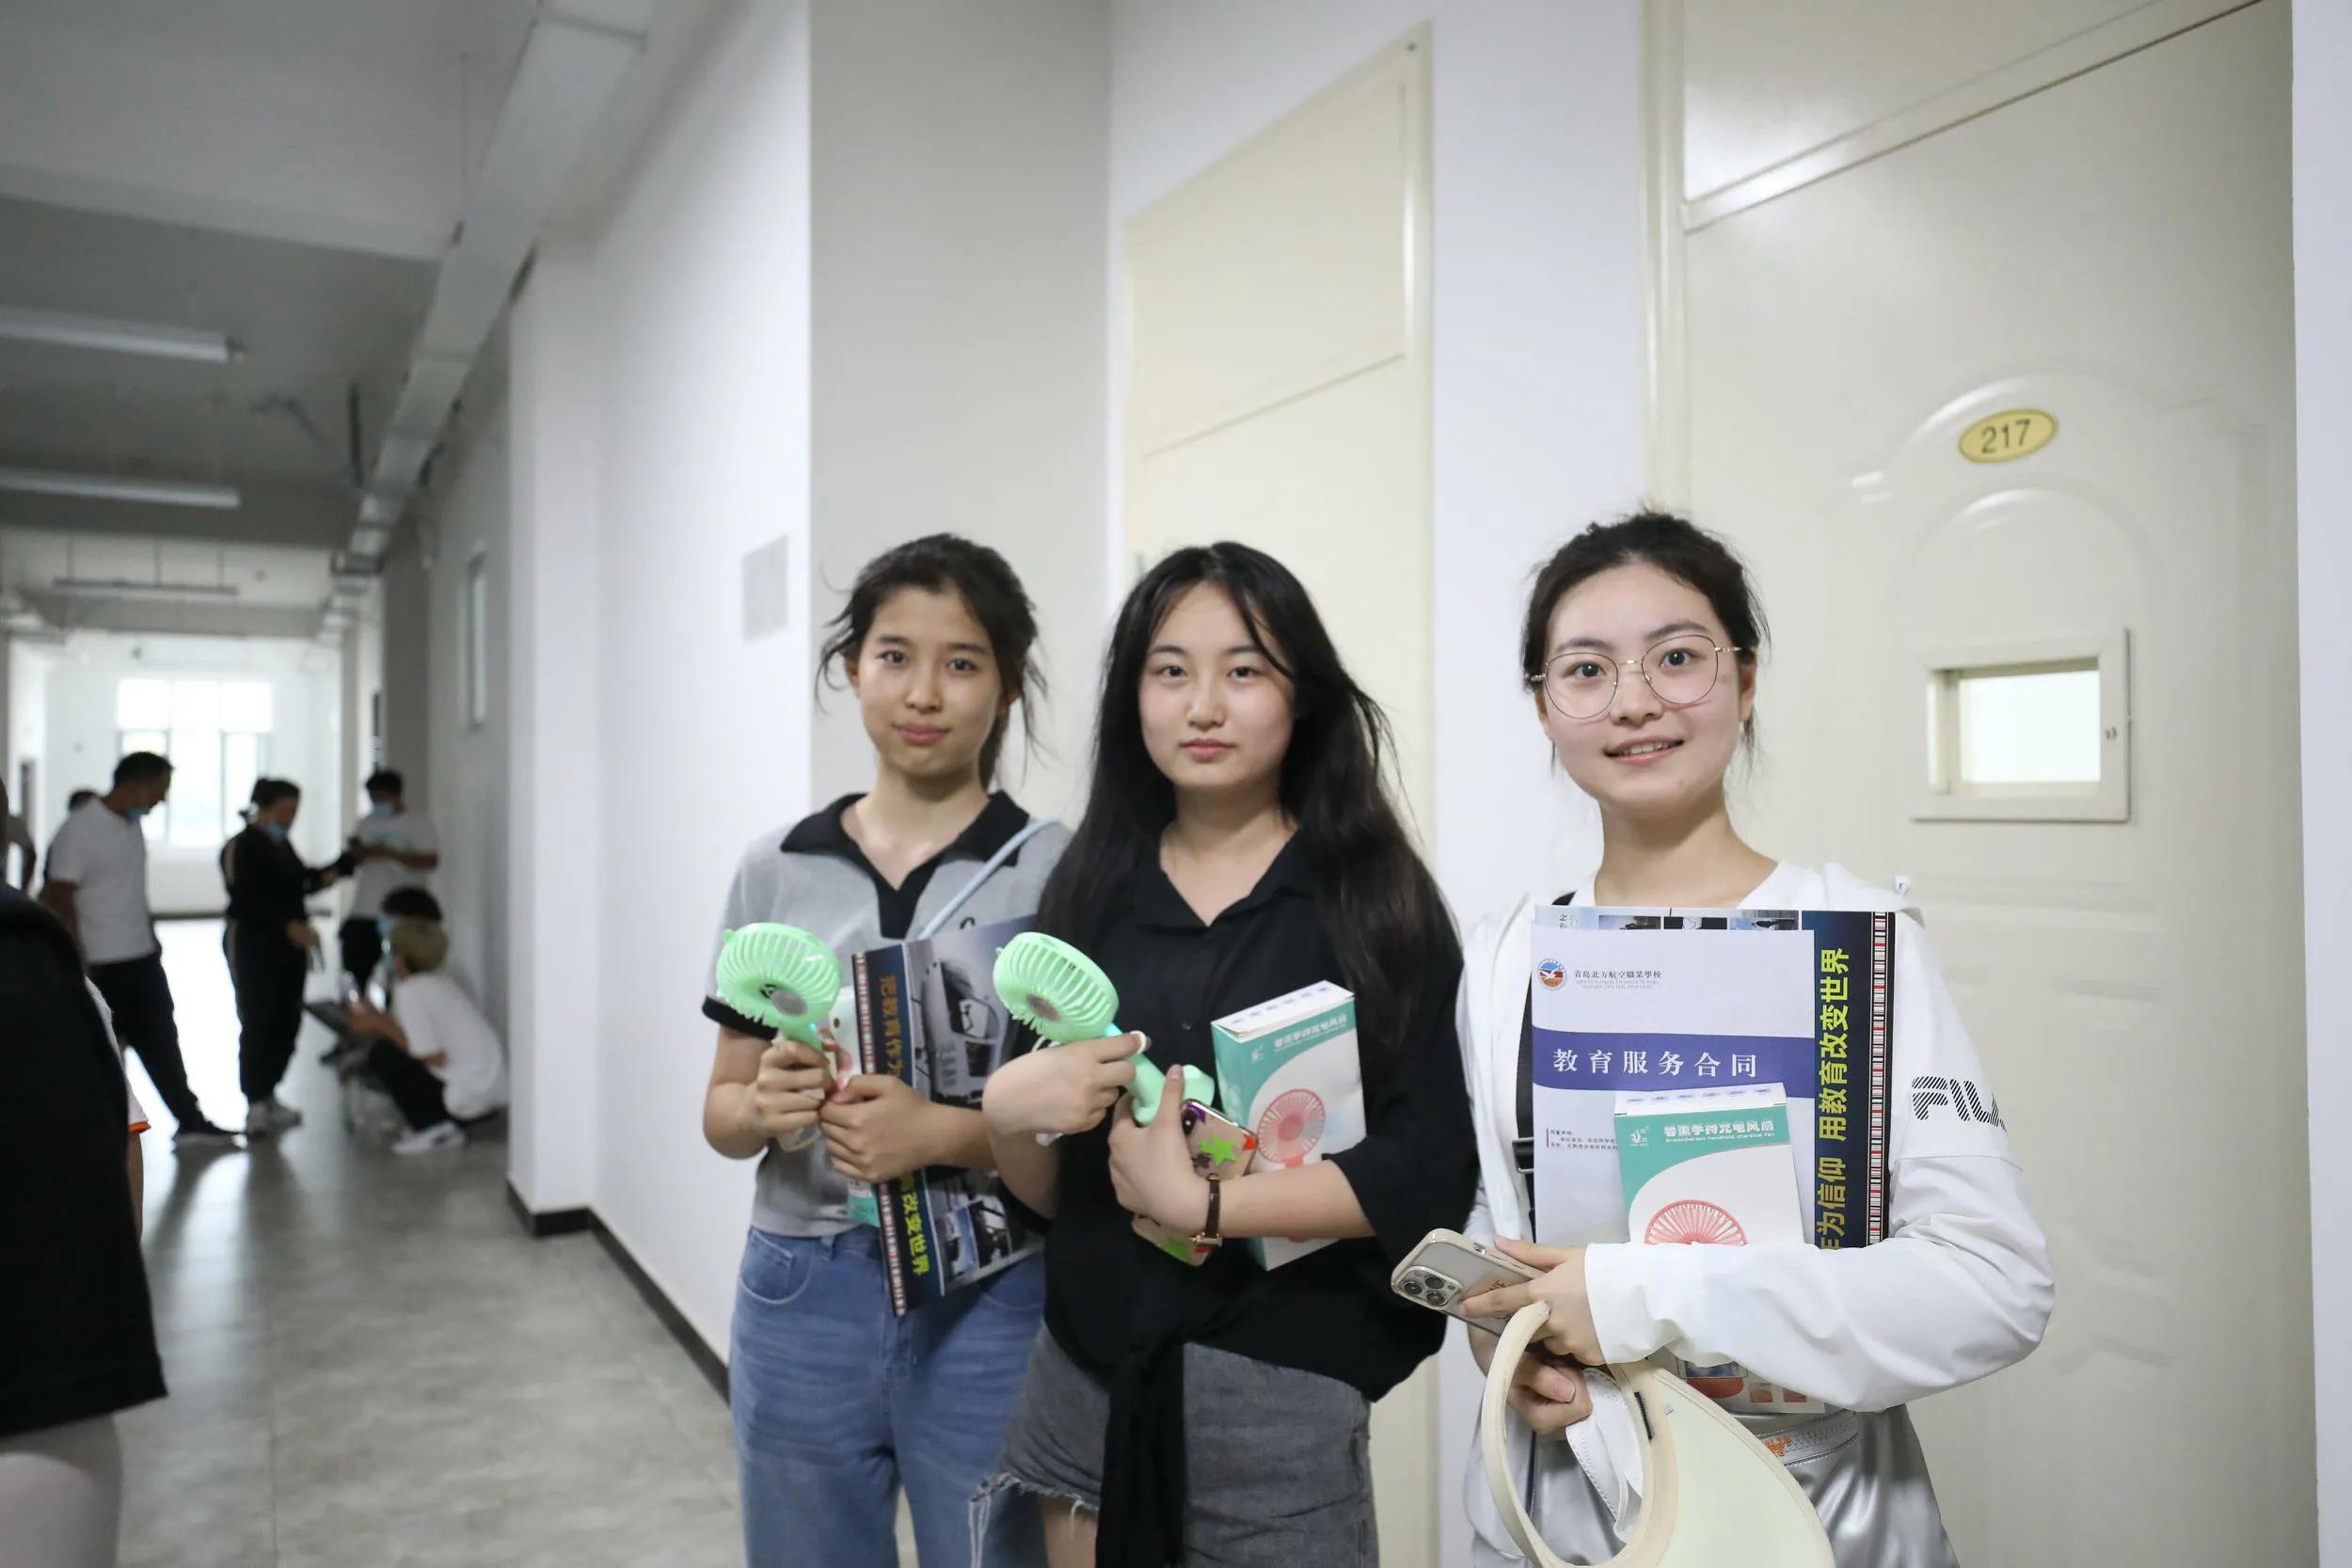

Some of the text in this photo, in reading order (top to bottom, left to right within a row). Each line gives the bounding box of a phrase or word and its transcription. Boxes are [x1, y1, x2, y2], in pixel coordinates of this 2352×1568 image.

[1981, 419, 2031, 454] 217
[1819, 948, 1851, 1142] 用教育改变世界
[1553, 1048, 1757, 1078] 教育服务合同
